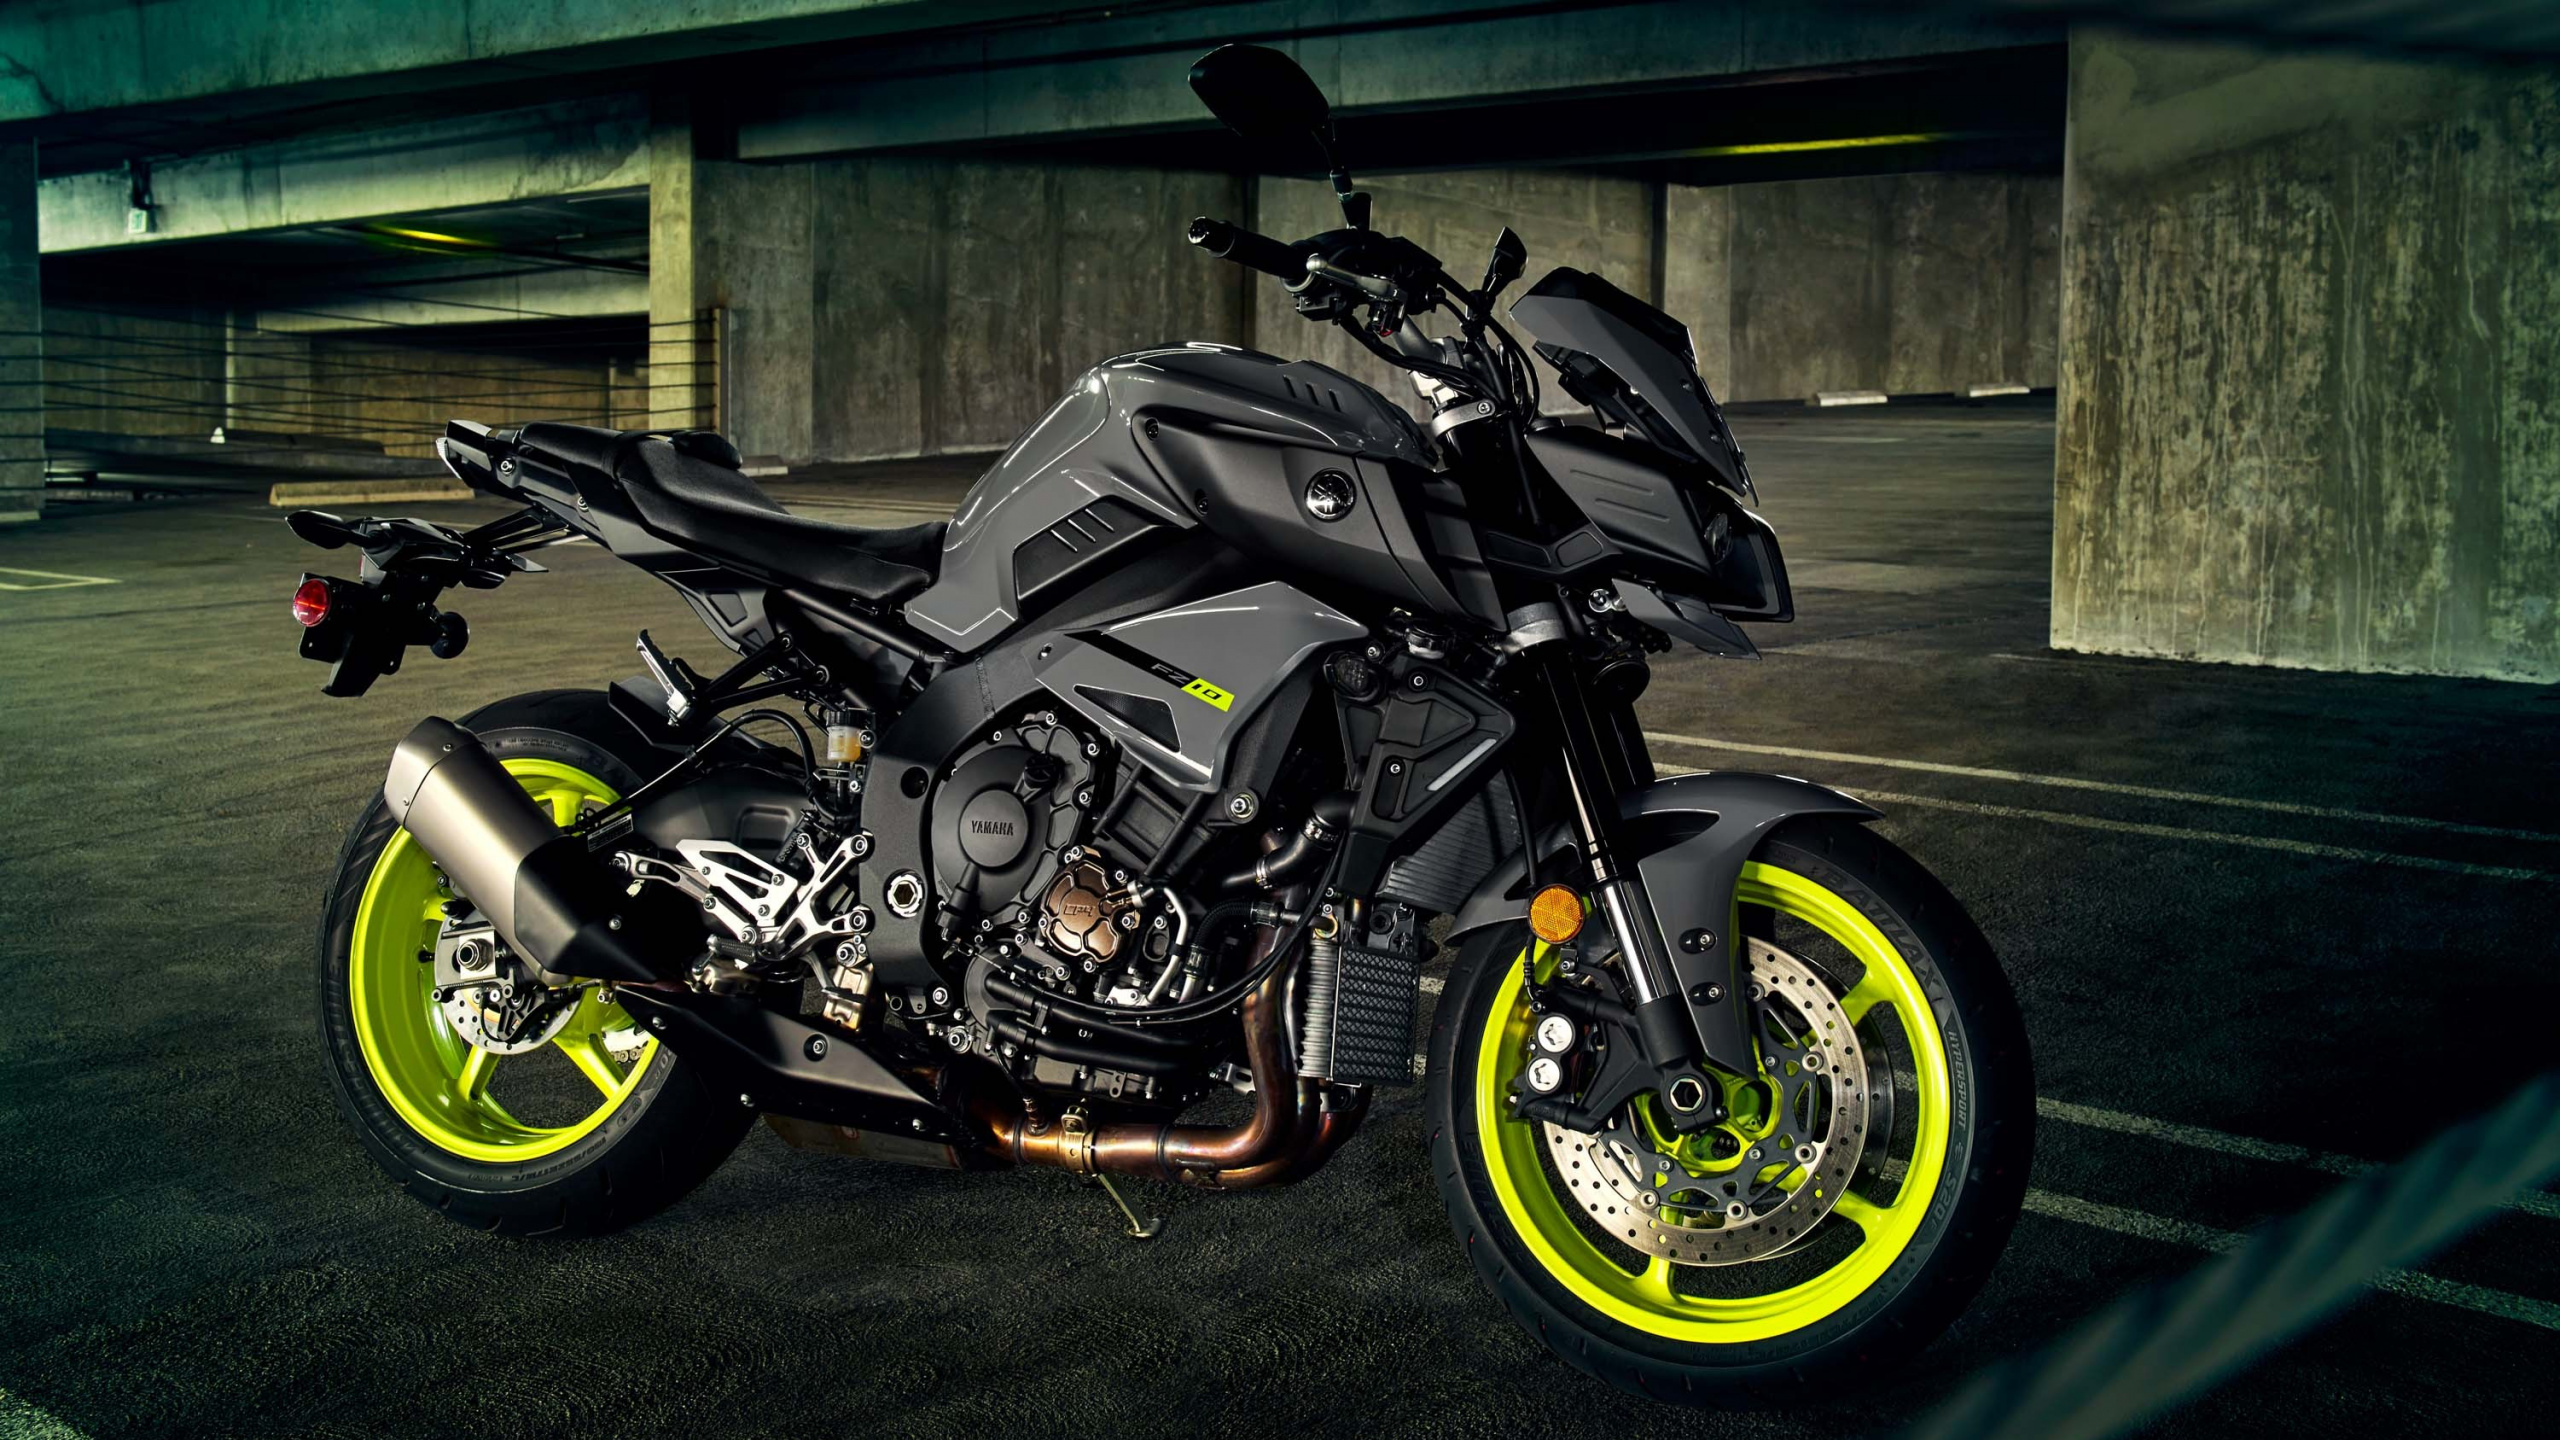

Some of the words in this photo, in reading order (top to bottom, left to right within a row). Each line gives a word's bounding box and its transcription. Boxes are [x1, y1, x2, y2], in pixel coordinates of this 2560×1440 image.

[971, 820, 1014, 836] YAMAHA
[1821, 865, 1942, 988] BATTLAX
[327, 962, 416, 1155] BRIDGESTONE
[1948, 1030, 1967, 1131] HYPERSPORT
